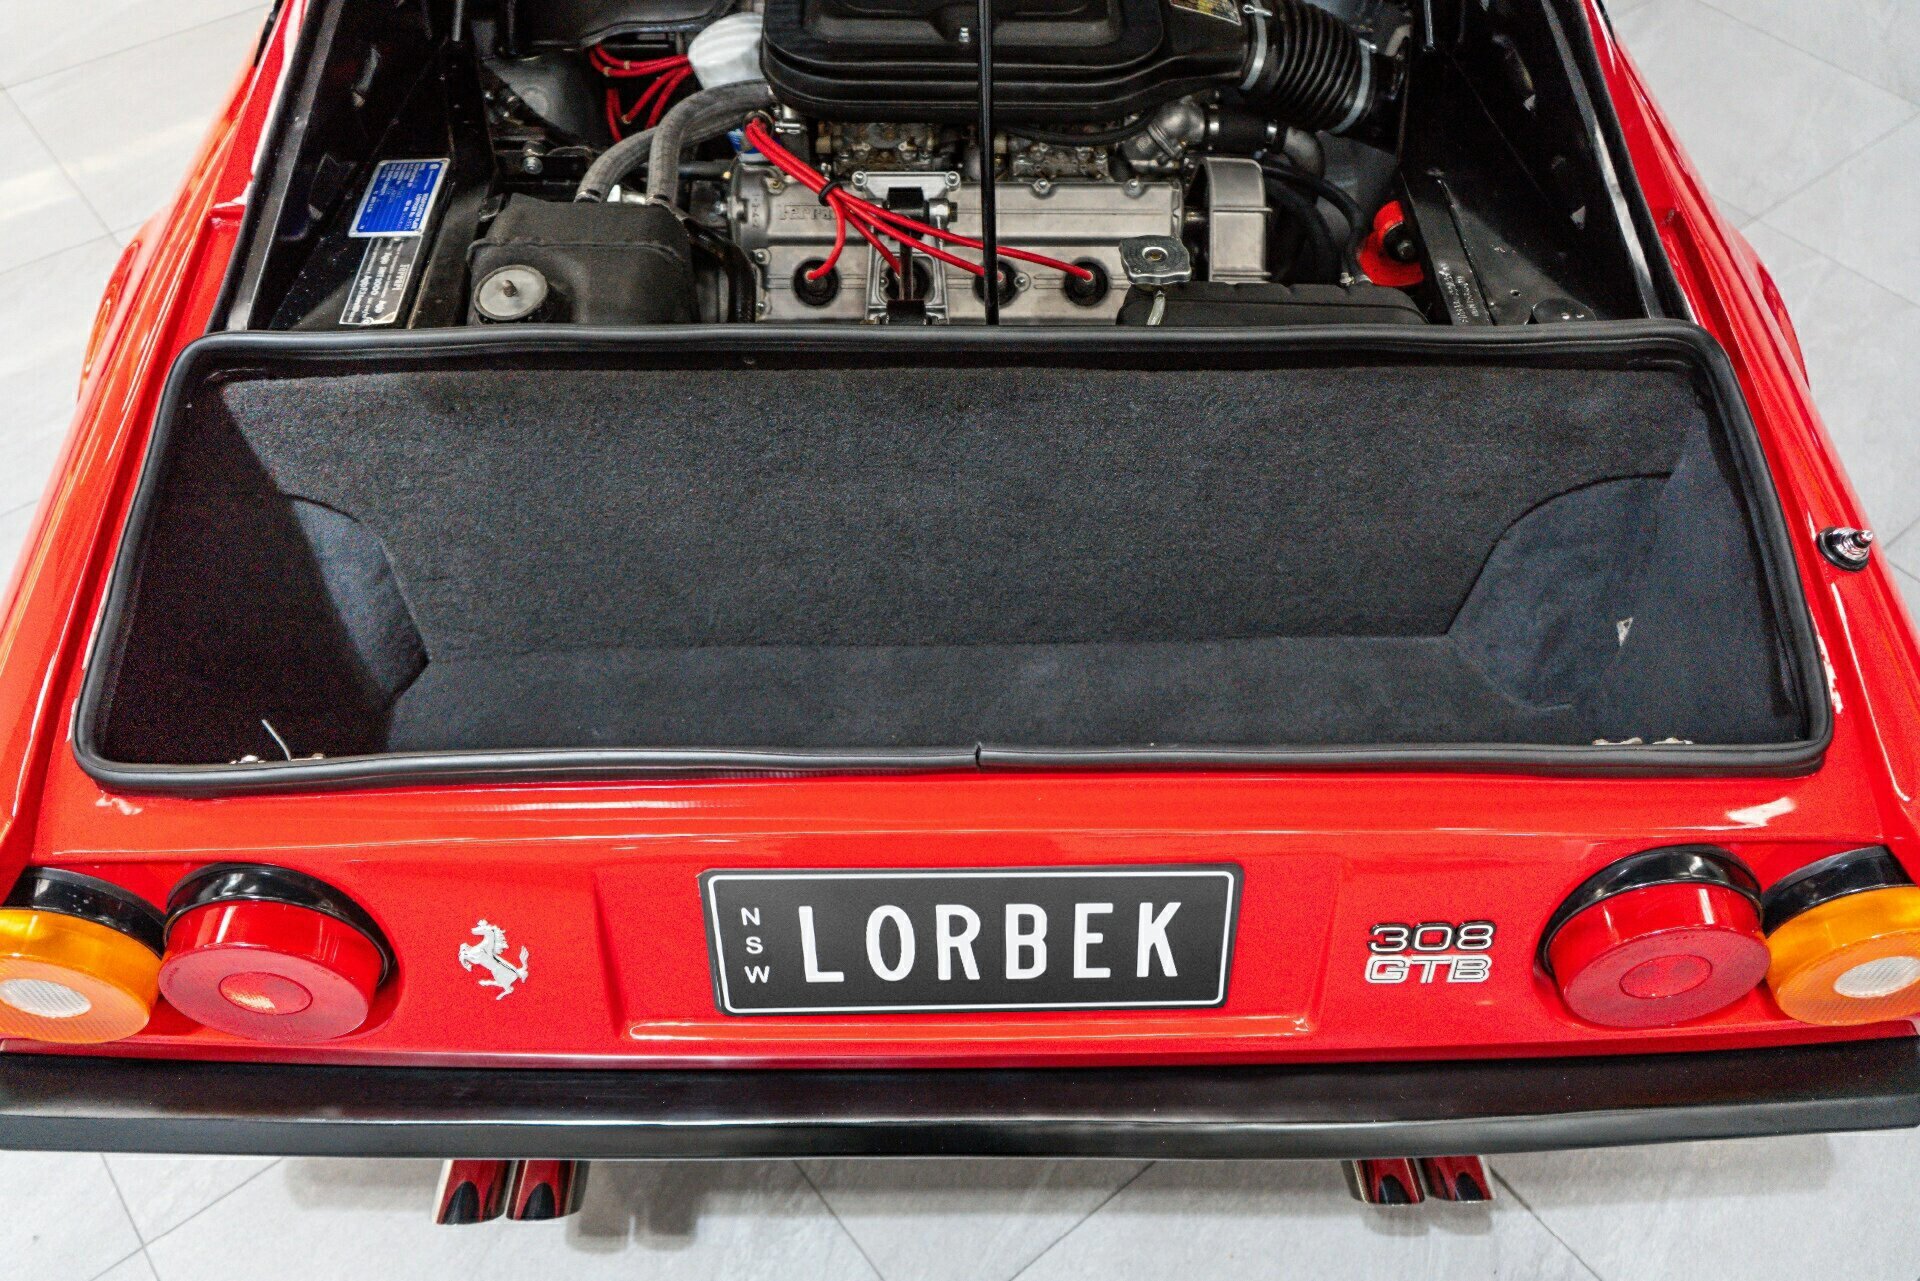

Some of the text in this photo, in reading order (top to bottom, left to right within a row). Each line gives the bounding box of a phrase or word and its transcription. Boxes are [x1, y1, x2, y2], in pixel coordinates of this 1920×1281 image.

[391, 263, 411, 291] Ferrari
[798, 901, 1182, 983] LORBEK
[1367, 920, 1497, 954] 308
[1364, 954, 1493, 984] GTB
